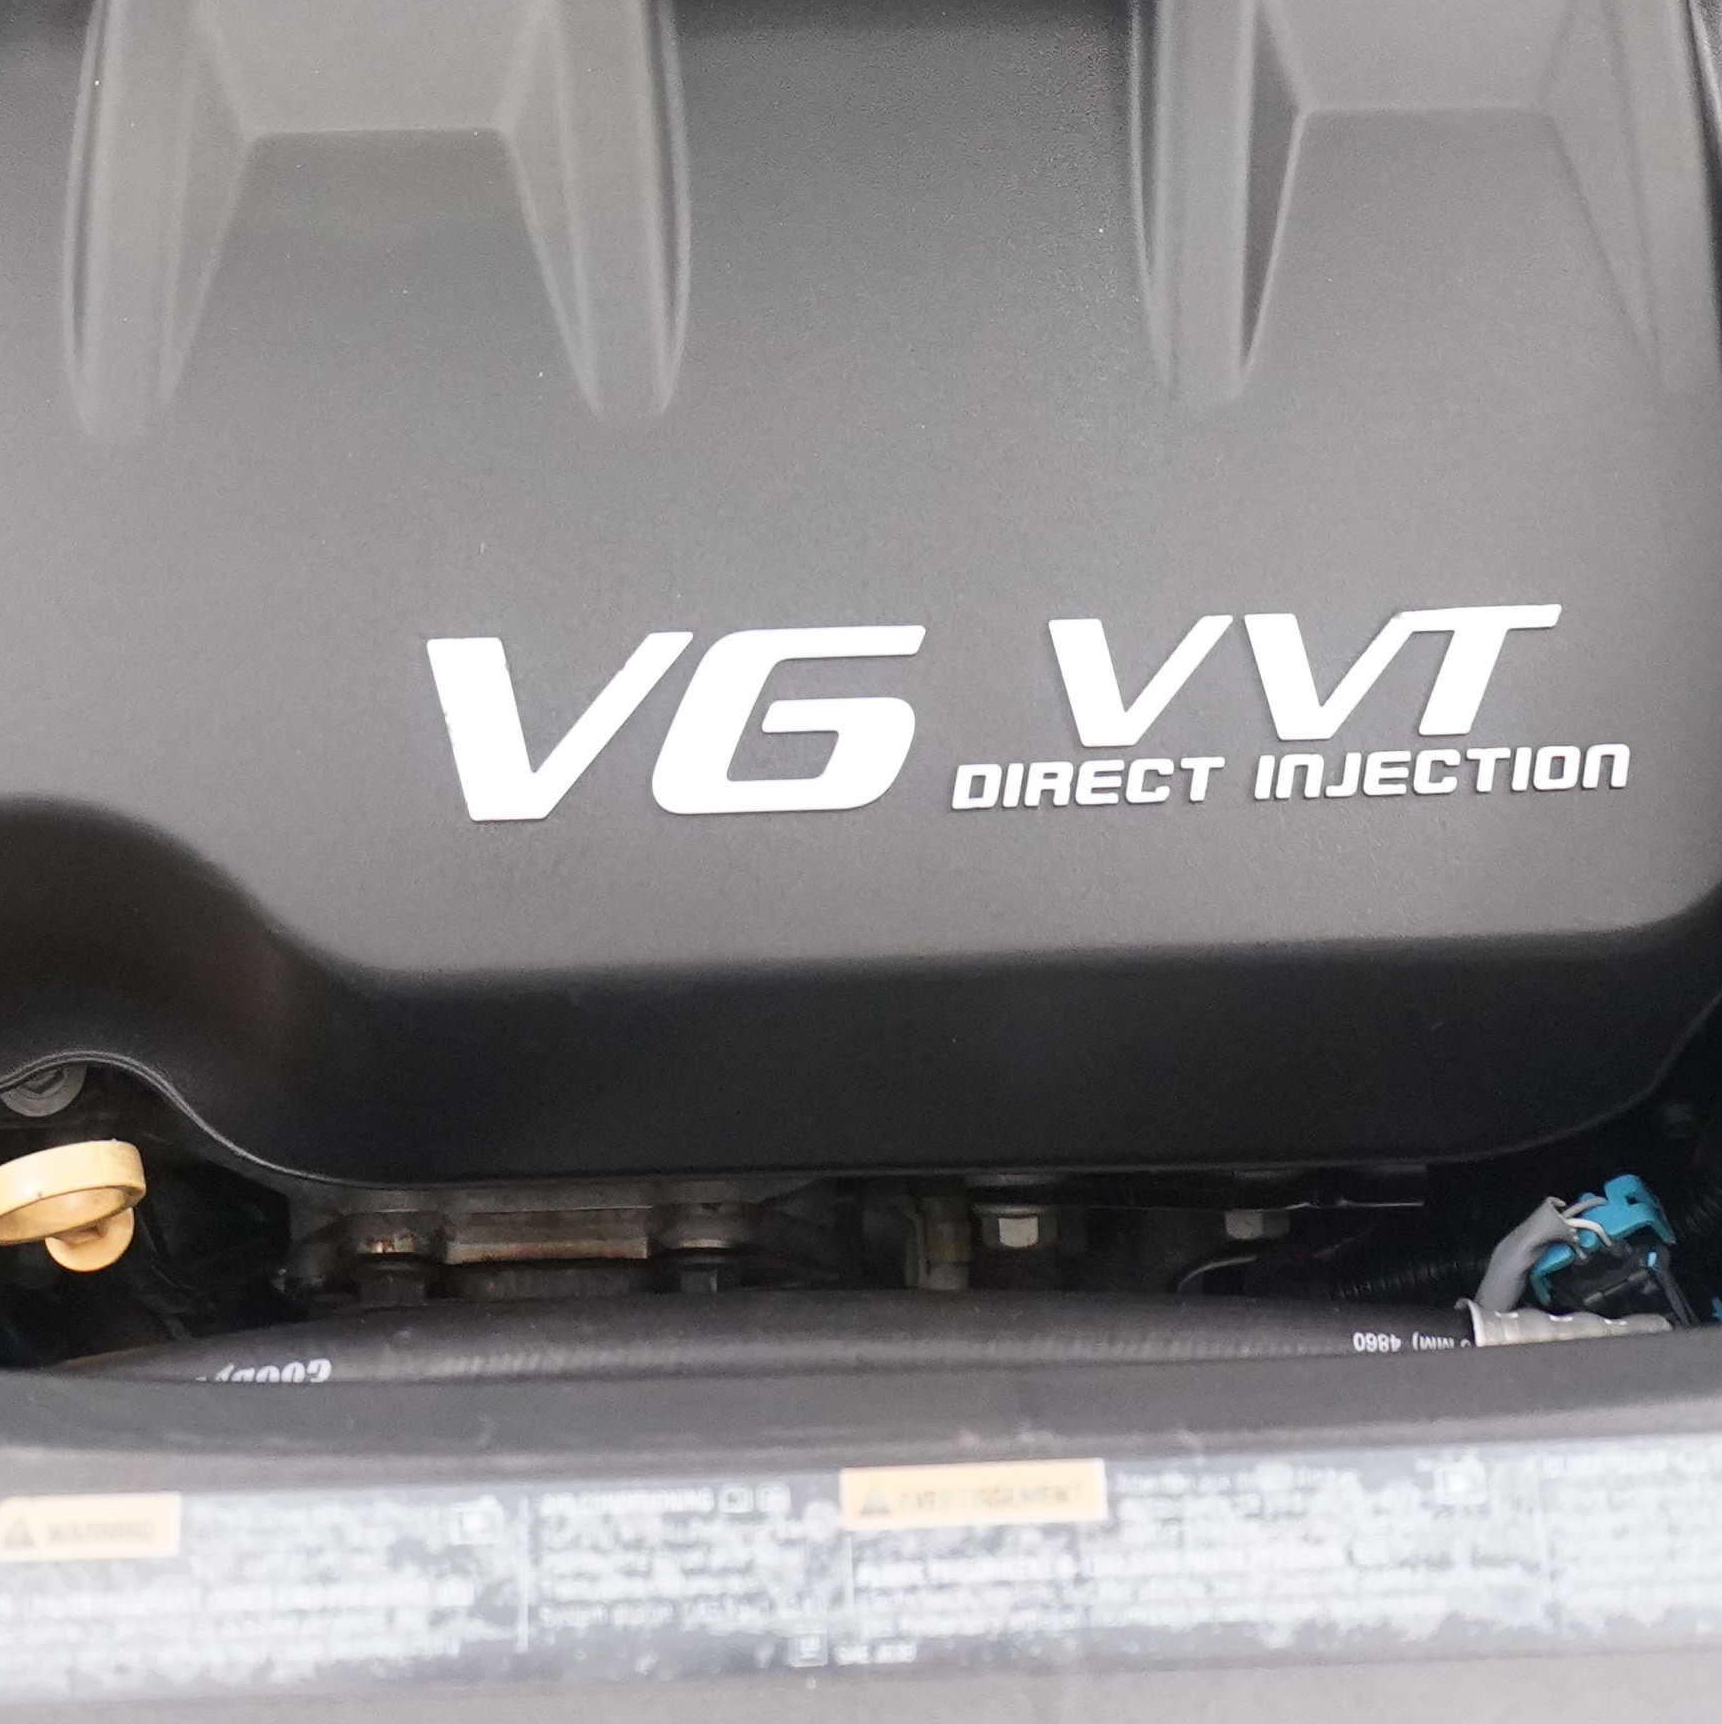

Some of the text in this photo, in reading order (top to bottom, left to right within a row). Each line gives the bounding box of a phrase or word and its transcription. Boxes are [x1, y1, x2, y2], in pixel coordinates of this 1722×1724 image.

[427, 625, 927, 821] V6
[1048, 603, 1563, 747] VVT
[952, 743, 1630, 809] DIRECT INJECTION
[1352, 1331, 1402, 1353] 4860
